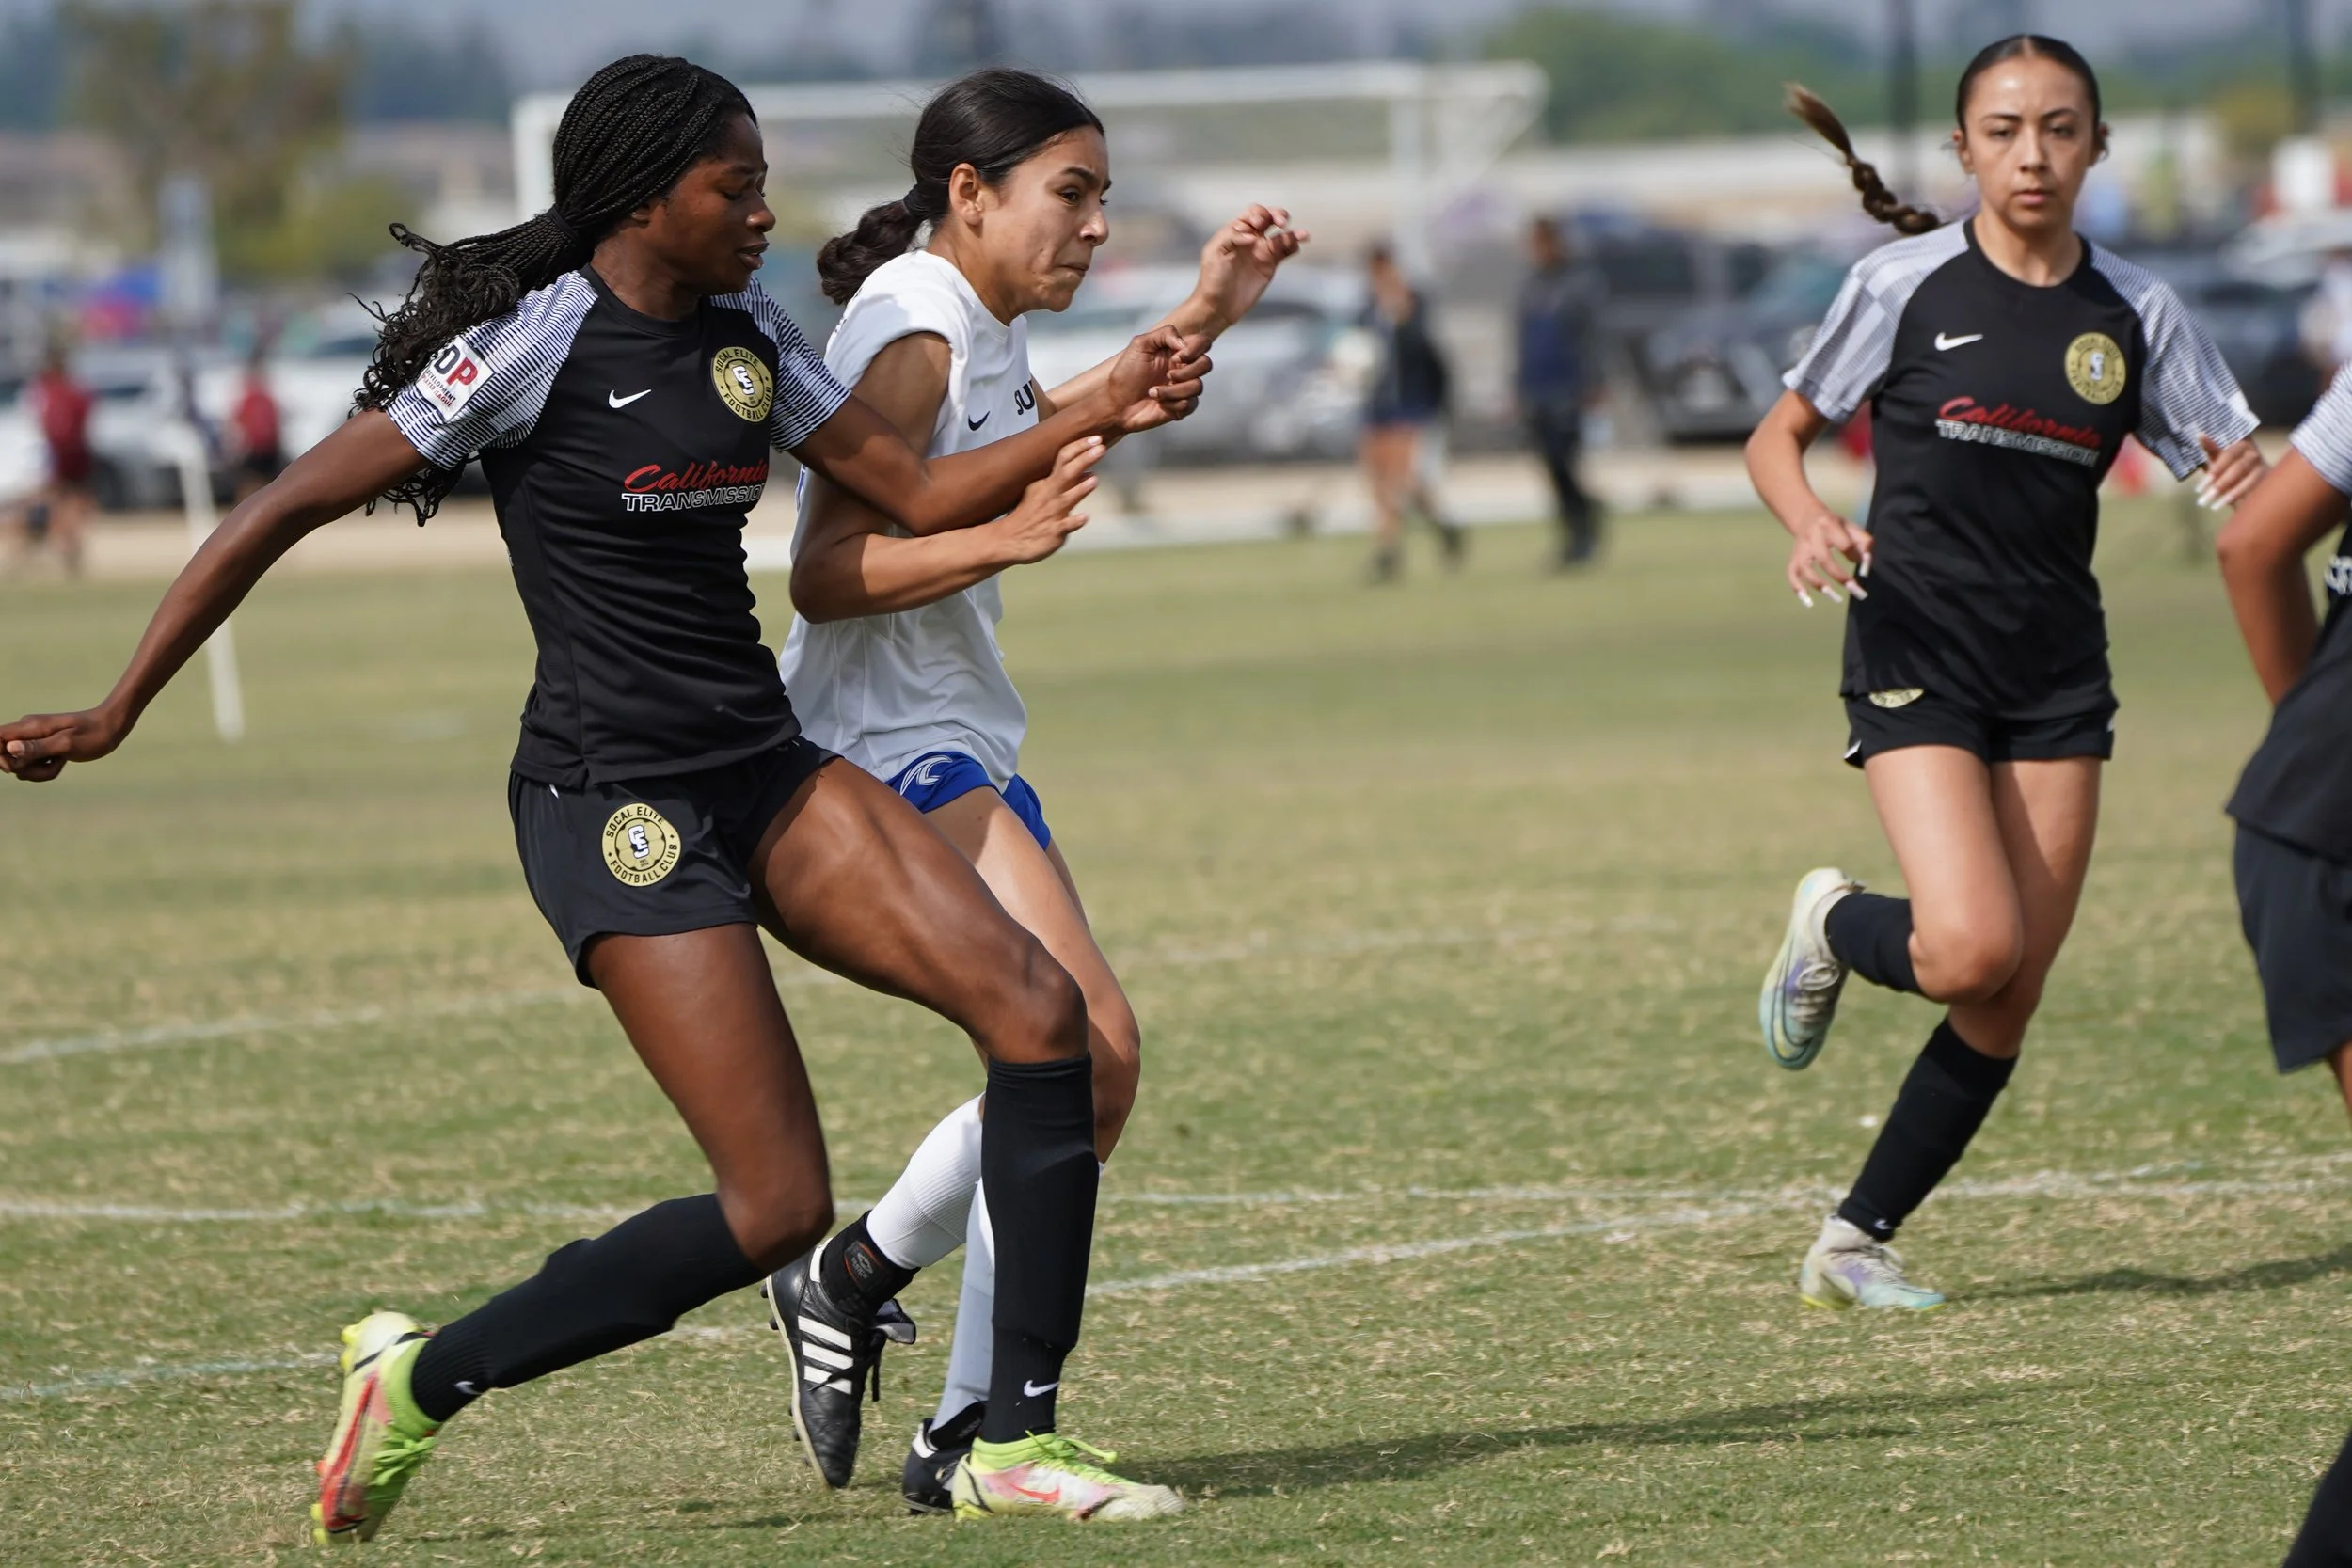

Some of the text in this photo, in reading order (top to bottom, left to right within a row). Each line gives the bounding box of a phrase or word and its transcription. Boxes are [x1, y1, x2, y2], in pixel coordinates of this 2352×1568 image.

[715, 348, 759, 373] SOCAL ELITE
[426, 369, 456, 403] DEVELOPMENT
[1014, 380, 1034, 415] SU
[723, 393, 763, 420] FOOTBALL
[1935, 418, 2100, 467] TRANSMISSION
[621, 483, 765, 512] TRANSMISSIO
[606, 806, 664, 838] SOCAL ELITE
[610, 844, 678, 883] FOOTBALL CLUB
